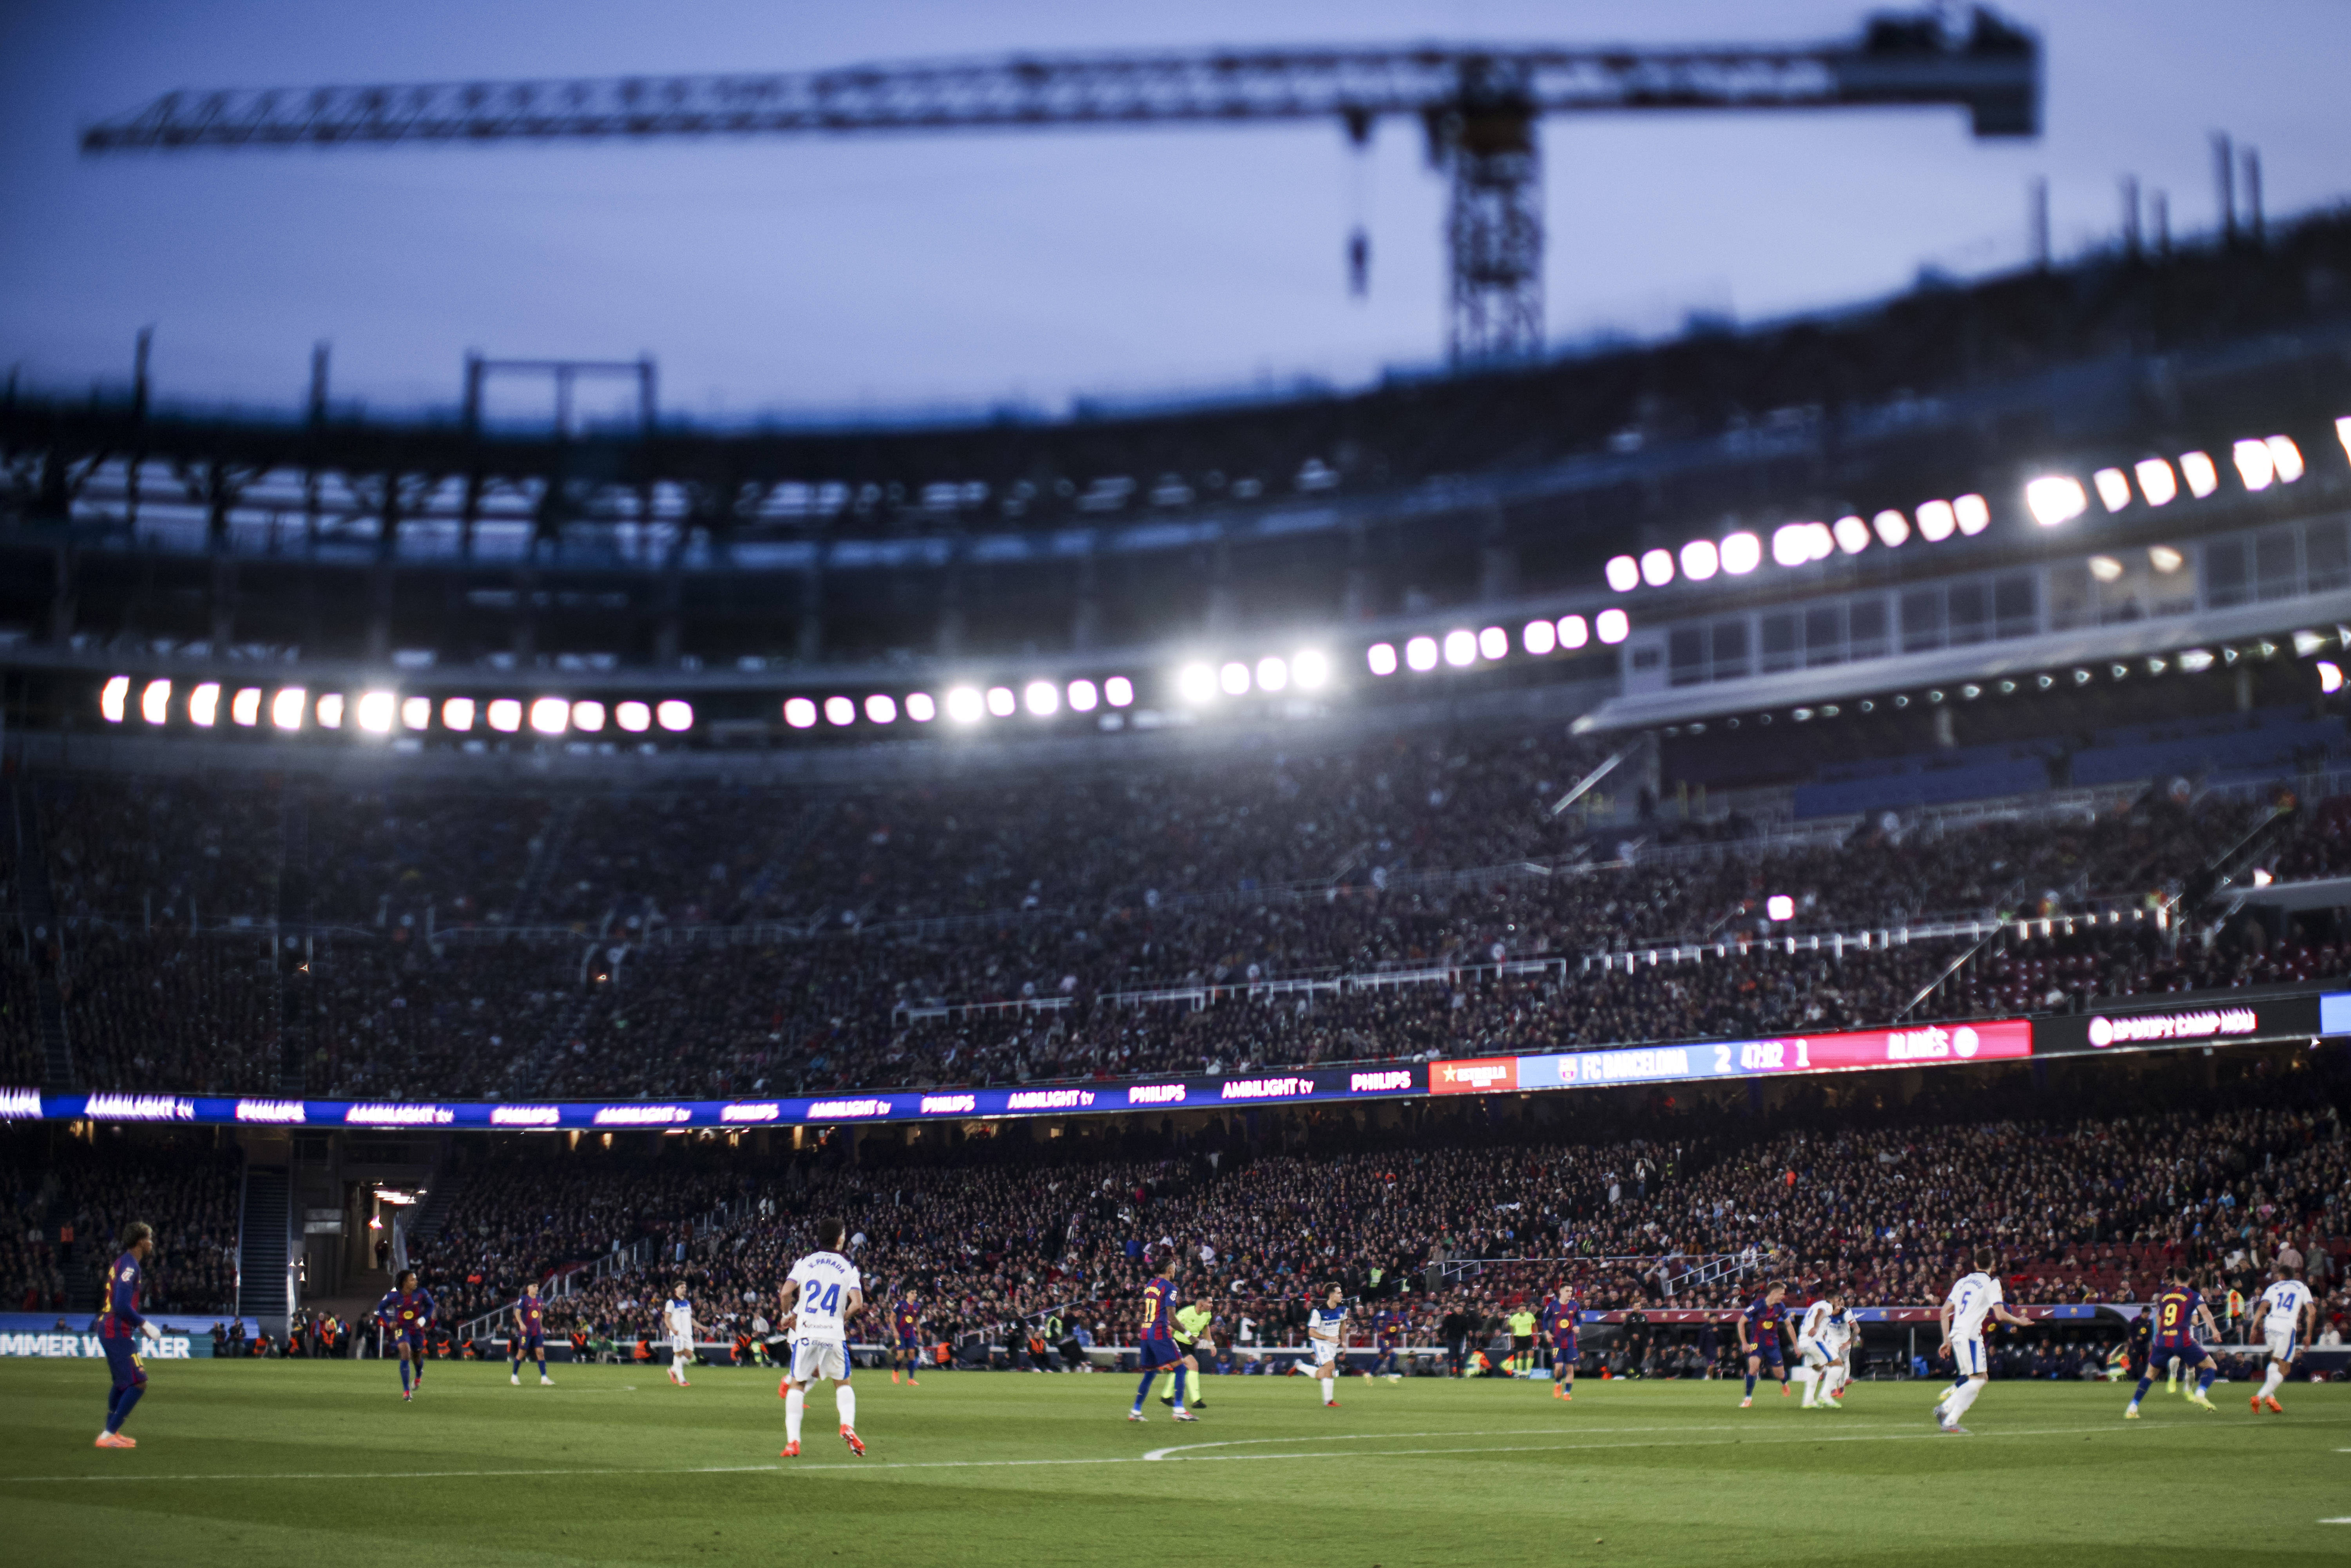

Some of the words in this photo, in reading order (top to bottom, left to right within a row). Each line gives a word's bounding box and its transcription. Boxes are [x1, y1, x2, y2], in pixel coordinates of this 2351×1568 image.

[2112, 1015, 2175, 1041] SPOTIFY
[2175, 1011, 2221, 1038] CAMP
[2220, 1008, 2258, 1034] NOU
[1887, 1025, 1948, 1059] ALAVÉS
[1582, 1054, 1602, 1080] FC
[1603, 1049, 1688, 1079] BARCELONA
[1714, 1044, 1732, 1073] 2
[1796, 1039, 1810, 1067] 1
[1351, 1071, 1411, 1092] PHILIPS
[1456, 1065, 1507, 1082] ESTRELLA
[1129, 1084, 1186, 1103] PHILIPS
[1222, 1077, 1298, 1099] AMBILIGHT
[1298, 1078, 1315, 1094] tv
[84, 1095, 176, 1118] AMBILIGHT
[176, 1099, 195, 1118] tv
[235, 1099, 305, 1122] PHILIPS
[808, 1099, 878, 1118] AMBILIGHT
[877, 1101, 892, 1115] tv
[921, 1095, 975, 1114] PHILIPS
[1007, 1090, 1080, 1110] AMBILIGHT
[1080, 1090, 1096, 1106] tv
[345, 1105, 435, 1124] AMBILIGHT
[435, 1109, 454, 1123] tv
[490, 1106, 560, 1124] PHILIPS
[594, 1106, 676, 1124] AMBILIGHT
[675, 1108, 692, 1122] tv
[721, 1103, 779, 1121] PHILIPS
[805, 1280, 840, 1316] 24
[1960, 1291, 1971, 1315] 5
[2277, 1293, 2296, 1313] 14
[1144, 1298, 1157, 1322] 11
[2164, 1303, 2178, 1326] 9
[82, 1334, 191, 1358] WKER
